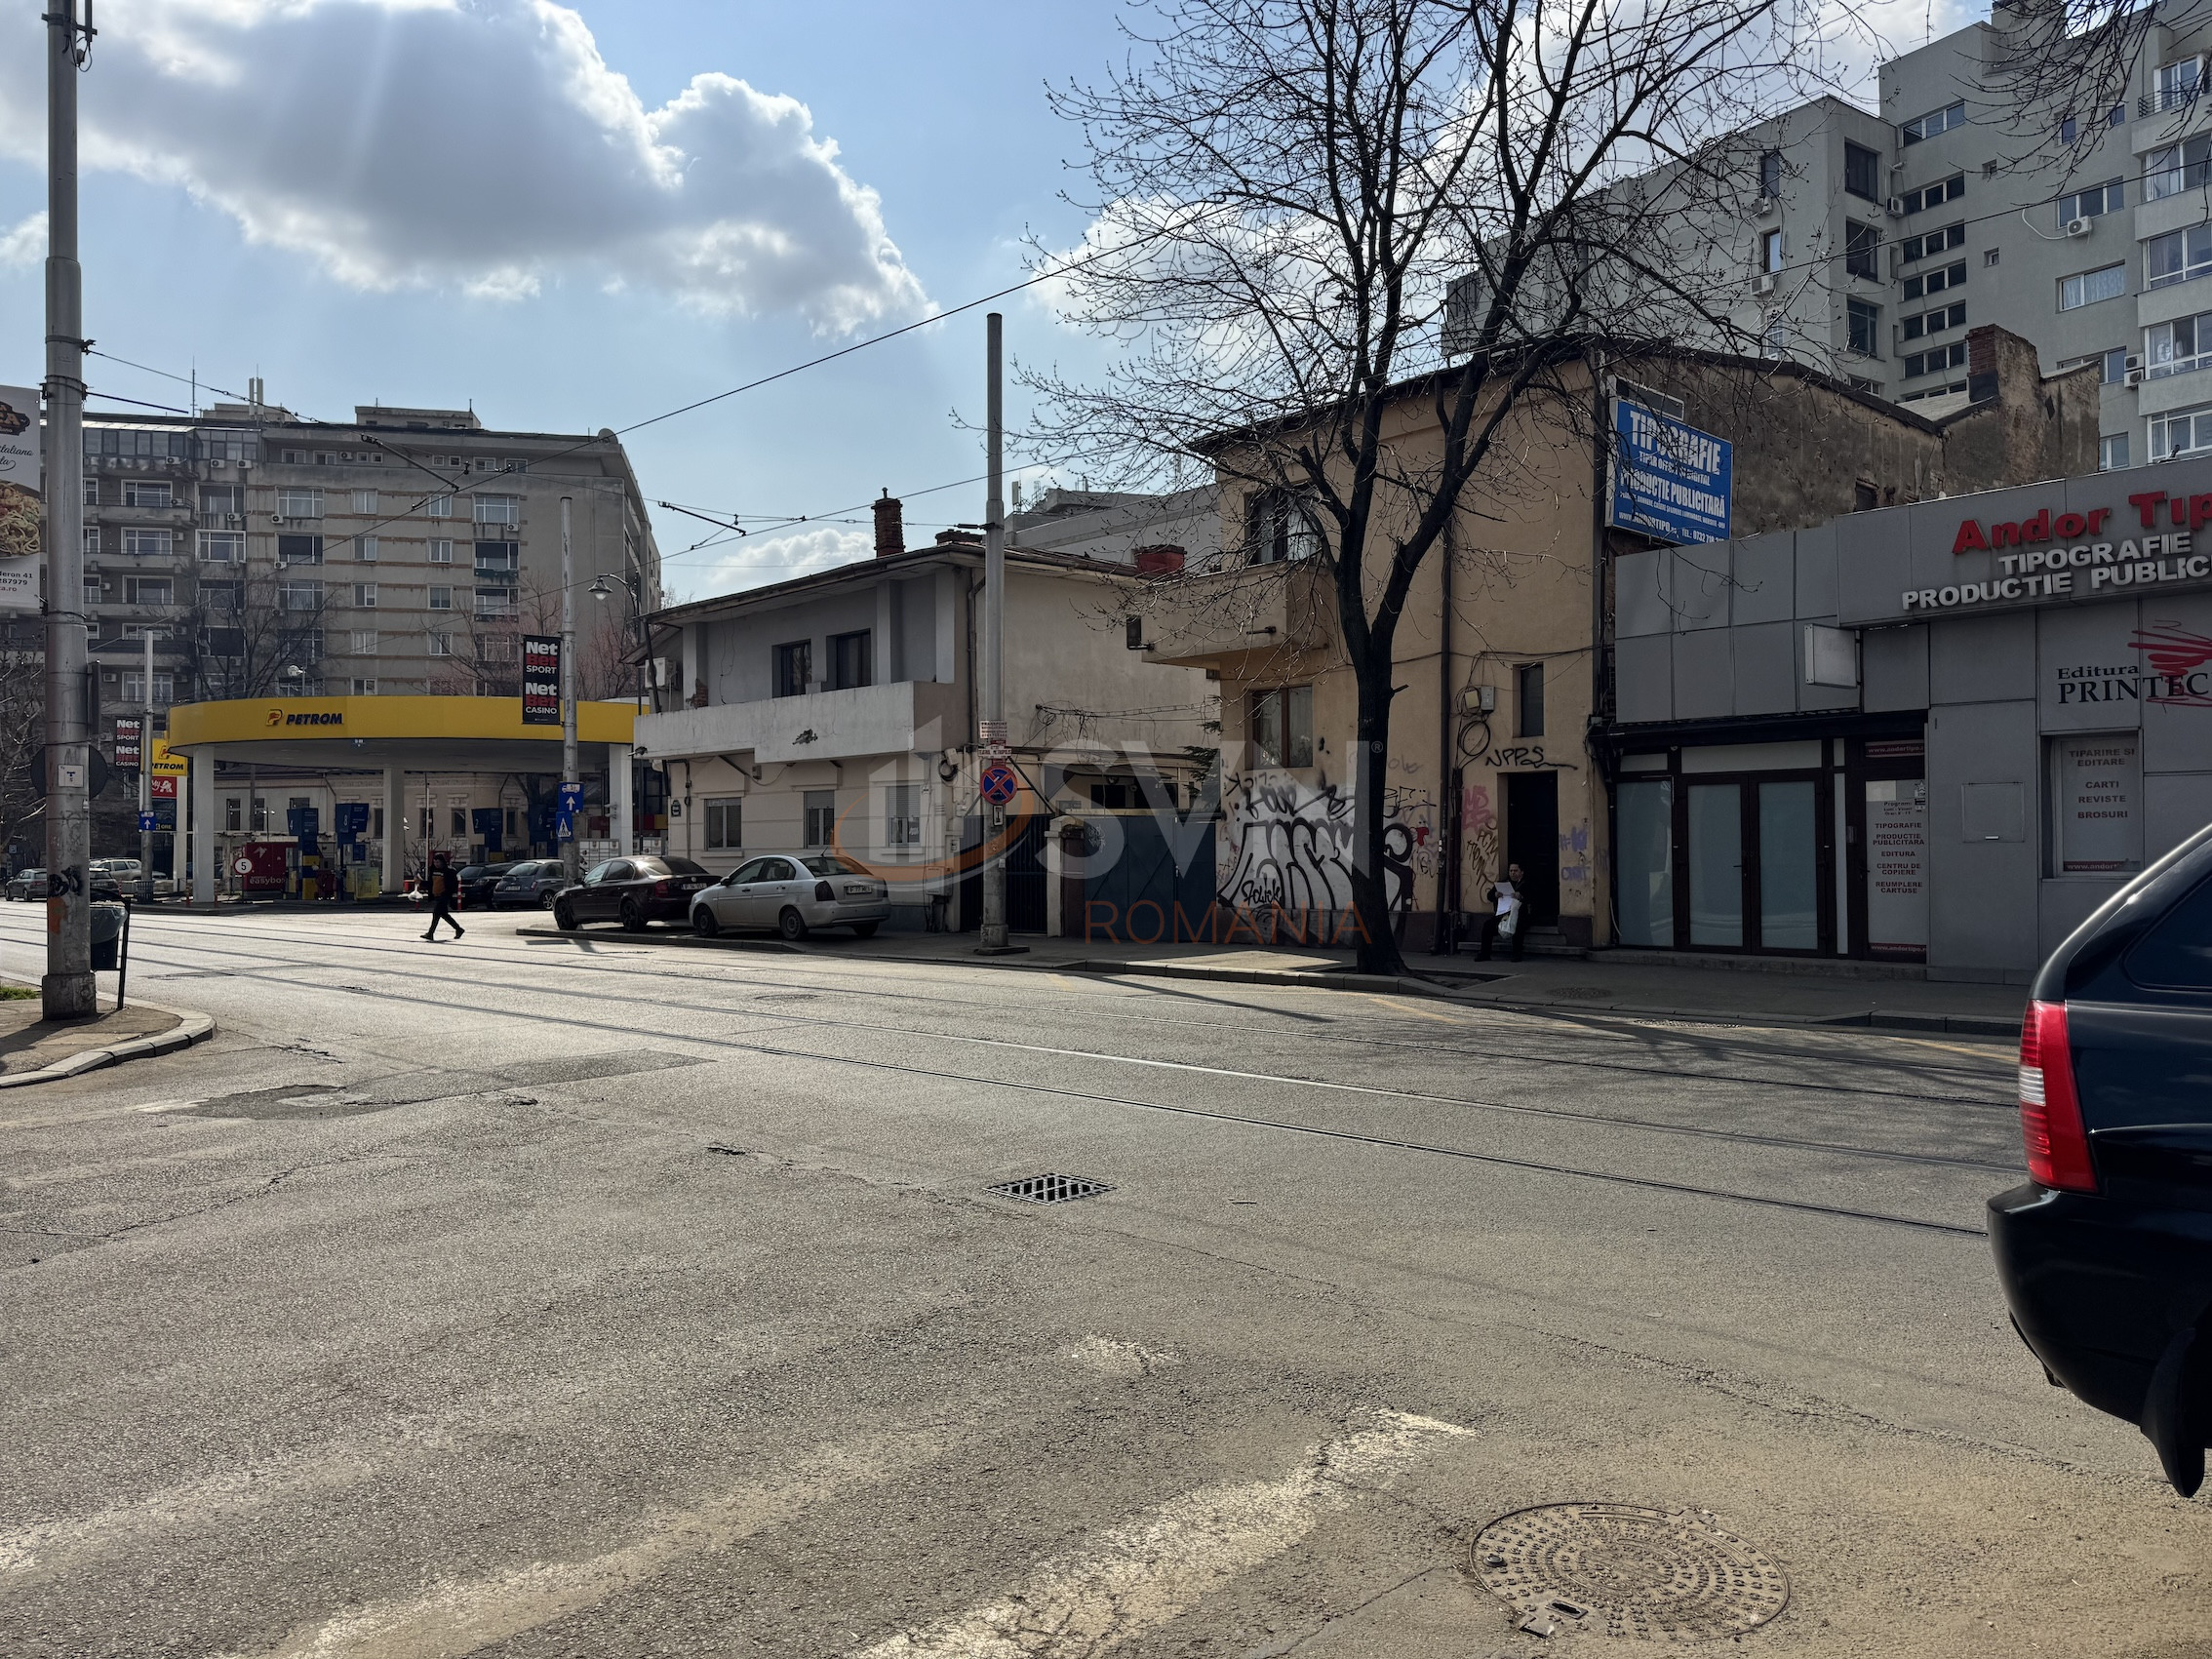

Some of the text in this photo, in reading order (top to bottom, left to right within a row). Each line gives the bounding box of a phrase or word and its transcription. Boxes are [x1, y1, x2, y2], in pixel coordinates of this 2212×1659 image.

[1630, 411, 1721, 476] TIPOGRAFIE
[1952, 506, 2113, 554] Andor
[1999, 531, 2192, 575] TIPOGRAFIE
[1902, 554, 2212, 611] PRODUCTIE PUBLIC
[527, 641, 558, 655] Net
[526, 654, 557, 667] Bet
[527, 665, 557, 674] SPORT
[2057, 665, 2140, 679] Editura
[526, 682, 557, 695] Net
[526, 693, 557, 707] Bet
[117, 720, 140, 729] Net
[286, 713, 343, 725] PETROM
[116, 746, 139, 755] Net
[2069, 748, 2120, 758] TIPARIRE
[2077, 758, 2125, 767] EDITARE
[2078, 795, 2126, 804] REVISTE
[241, 861, 247, 871] 5
